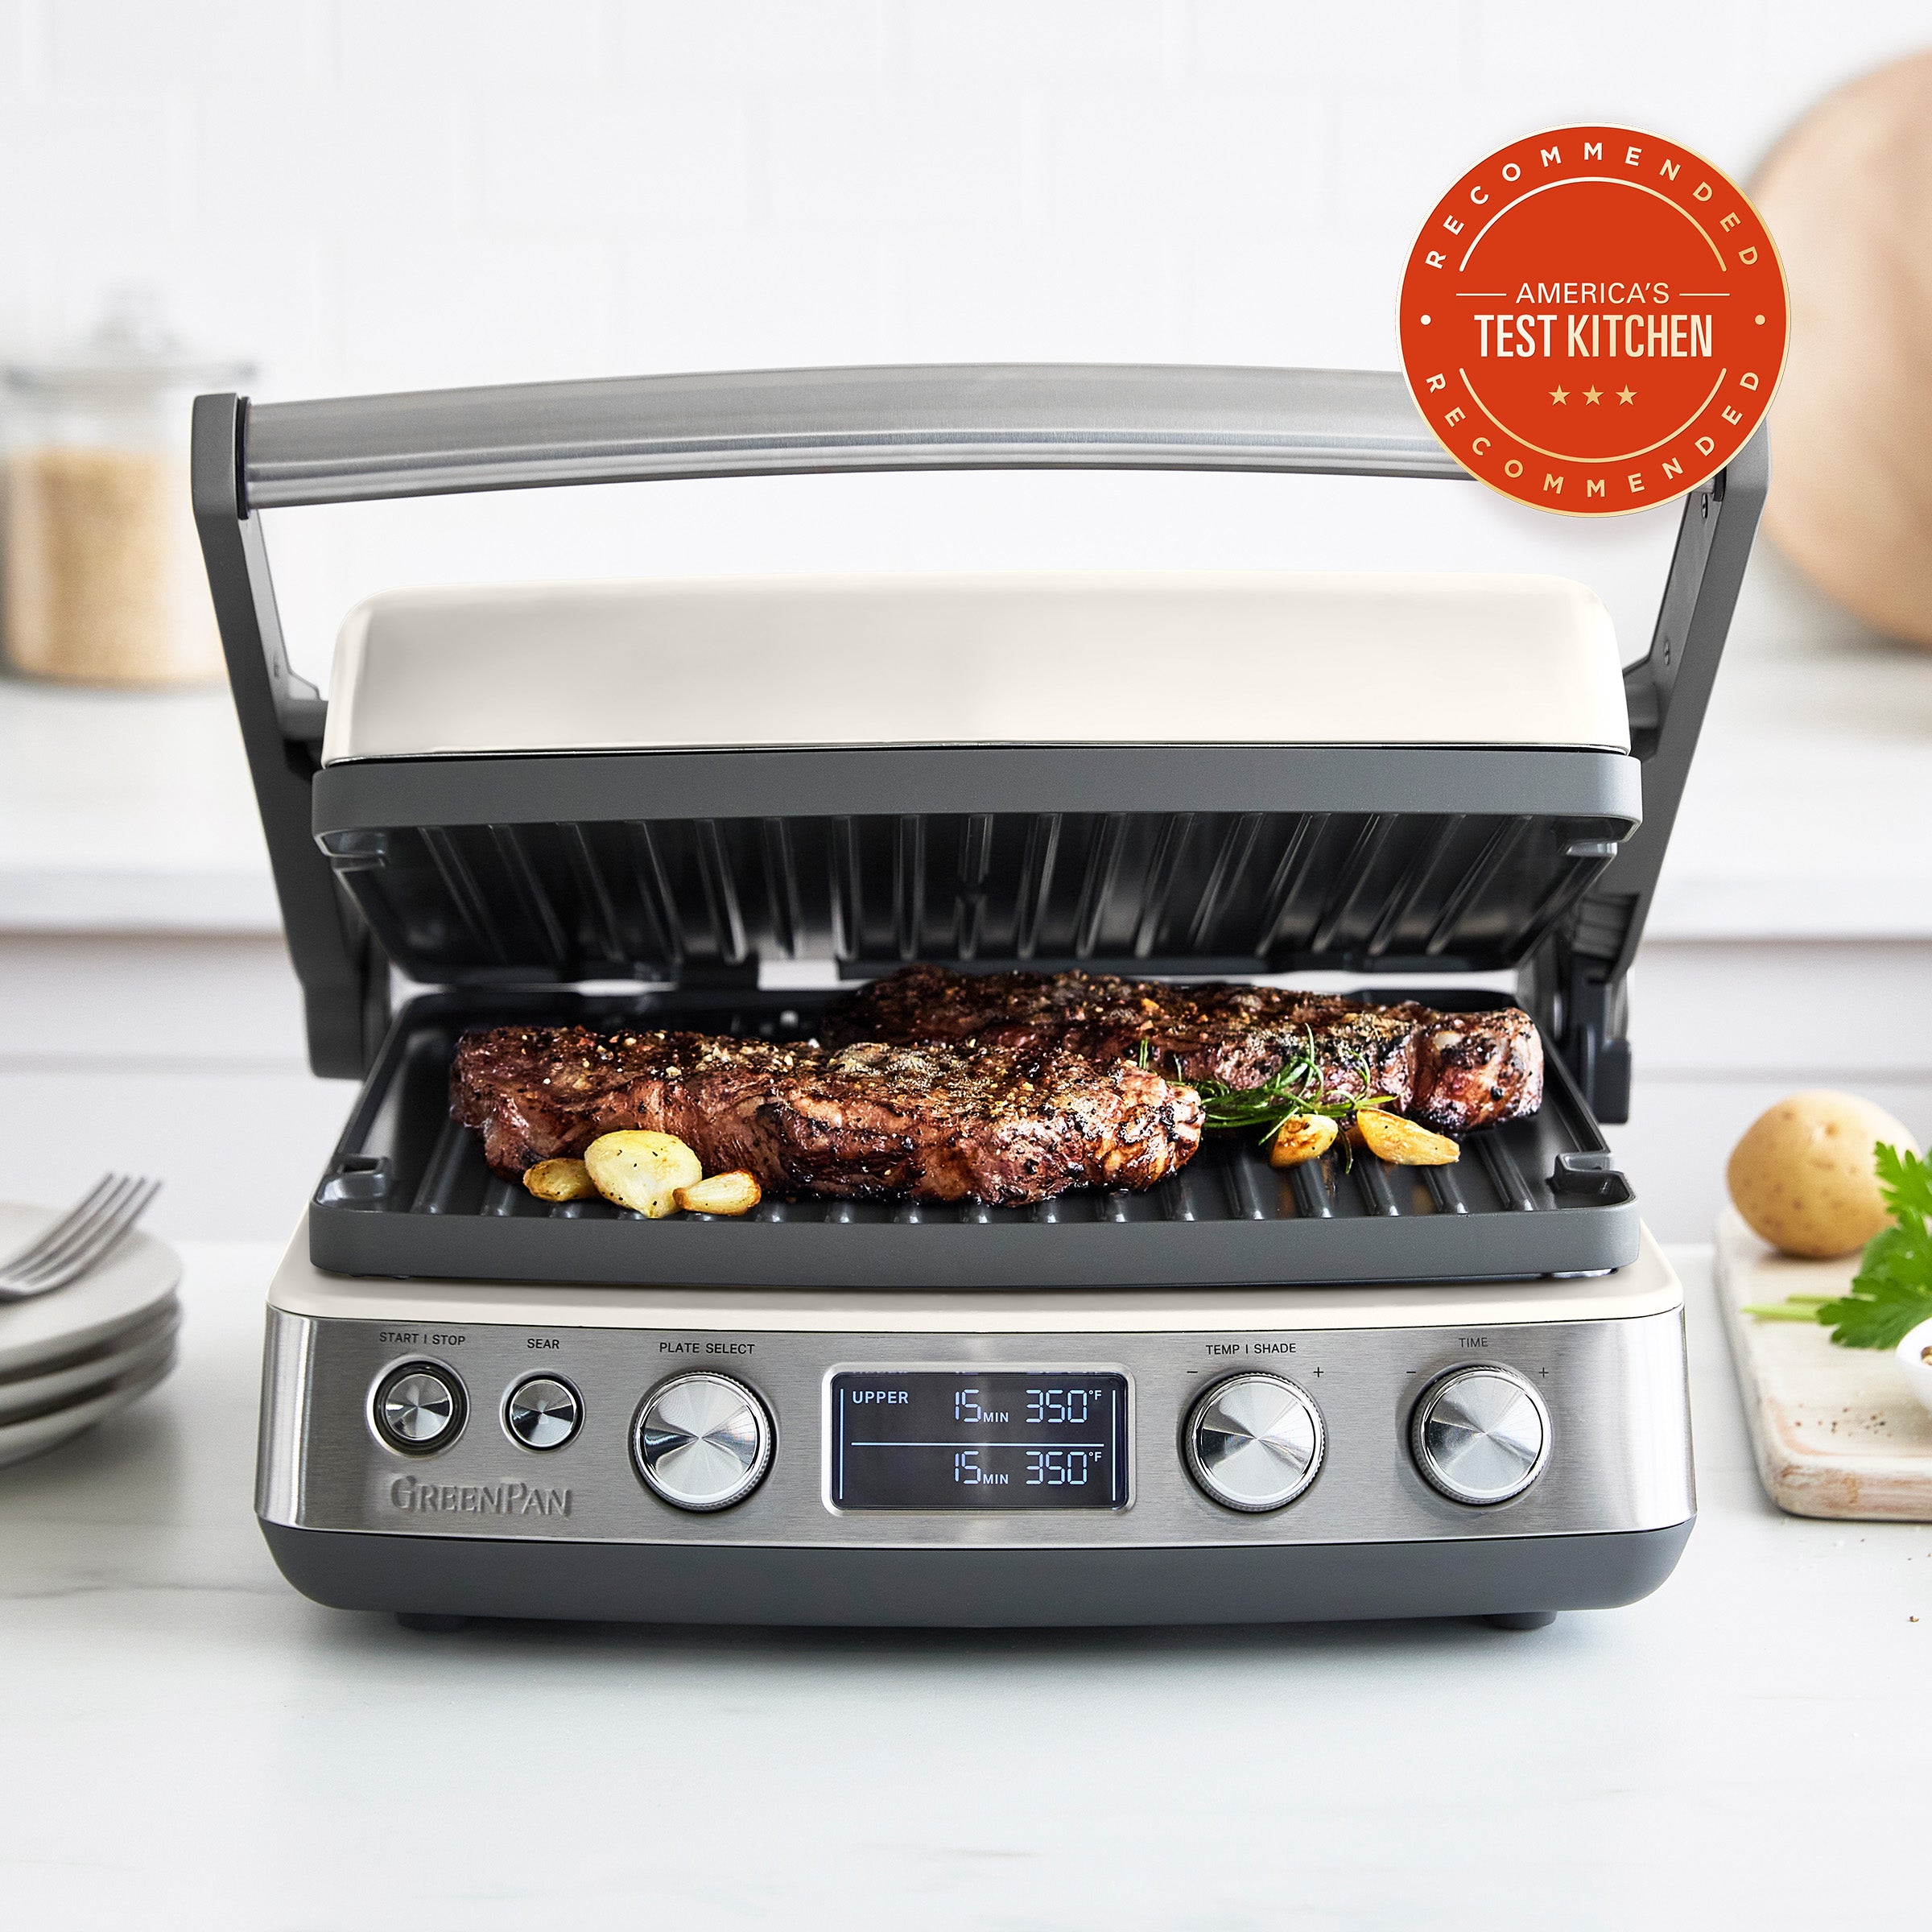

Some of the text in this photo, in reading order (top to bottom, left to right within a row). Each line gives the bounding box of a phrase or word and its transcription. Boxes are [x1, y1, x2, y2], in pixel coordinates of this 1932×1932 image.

[379, 1332, 419, 1343] START
[431, 1335, 465, 1345] STOP
[526, 1339, 560, 1349] SEAR
[1459, 1337, 1488, 1348] TIME
[659, 1342, 755, 1354] PLATE SELECT
[1206, 1344, 1240, 1355] TEMP
[1253, 1344, 1296, 1354] SHADE
[852, 1391, 909, 1404] UPPER
